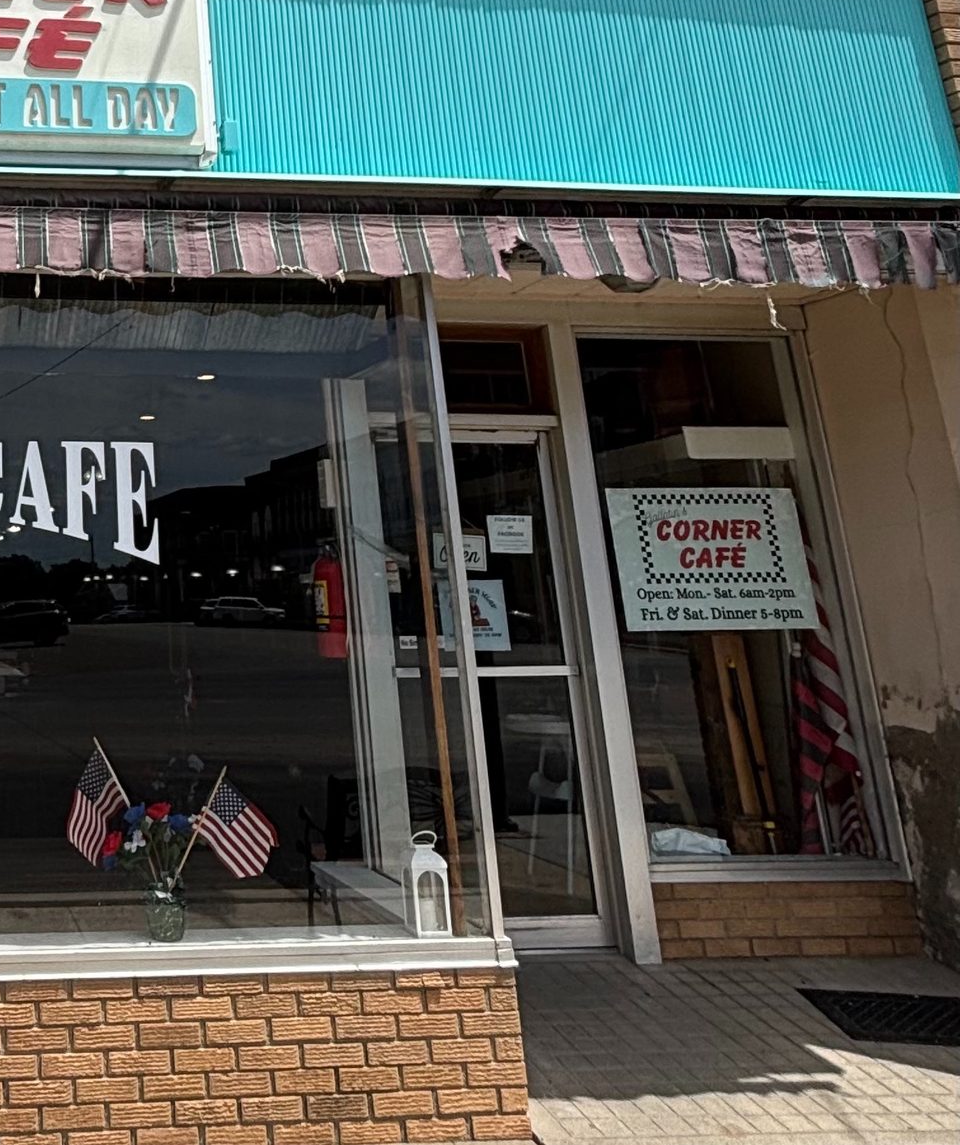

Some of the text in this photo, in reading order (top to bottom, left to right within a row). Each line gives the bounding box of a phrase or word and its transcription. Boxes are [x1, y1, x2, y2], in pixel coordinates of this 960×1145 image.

[22, 82, 94, 129] ALL
[106, 84, 180, 132] DAY
[656, 519, 762, 542] CORNER
[439, 544, 481, 564] Oen
[679, 542, 747, 569] CAFÉ
[636, 587, 674, 603] Open:
[713, 587, 737, 599] Sat.
[739, 587, 796, 601] 6am-2pm
[640, 606, 805, 623] Fri. & Sat. Dinner 5-8pm
